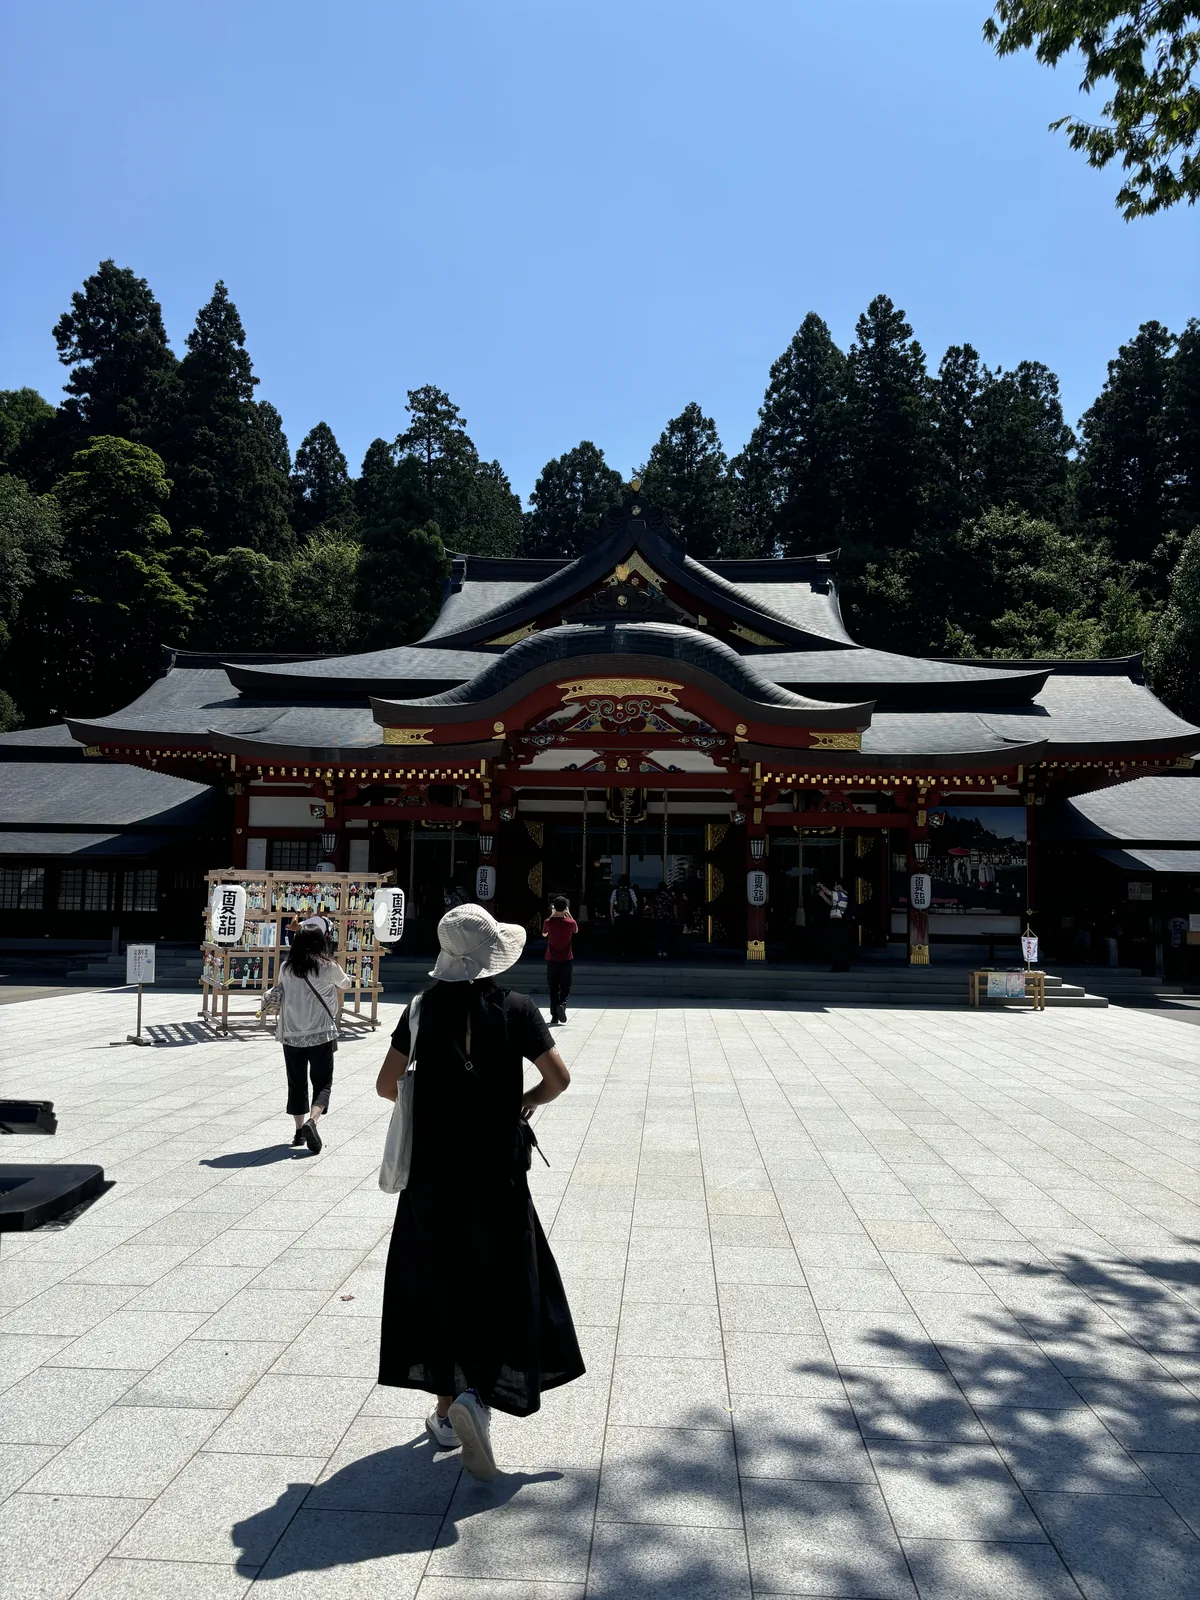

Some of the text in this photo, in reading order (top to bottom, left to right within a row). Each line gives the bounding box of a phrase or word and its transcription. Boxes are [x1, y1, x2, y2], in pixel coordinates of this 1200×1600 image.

[479, 869, 489, 896] 夏詣
[754, 874, 764, 902] 夏詣
[914, 877, 925, 905] 夏詣
[218, 890, 237, 936] 夏詣
[389, 893, 403, 937] 夏詣
